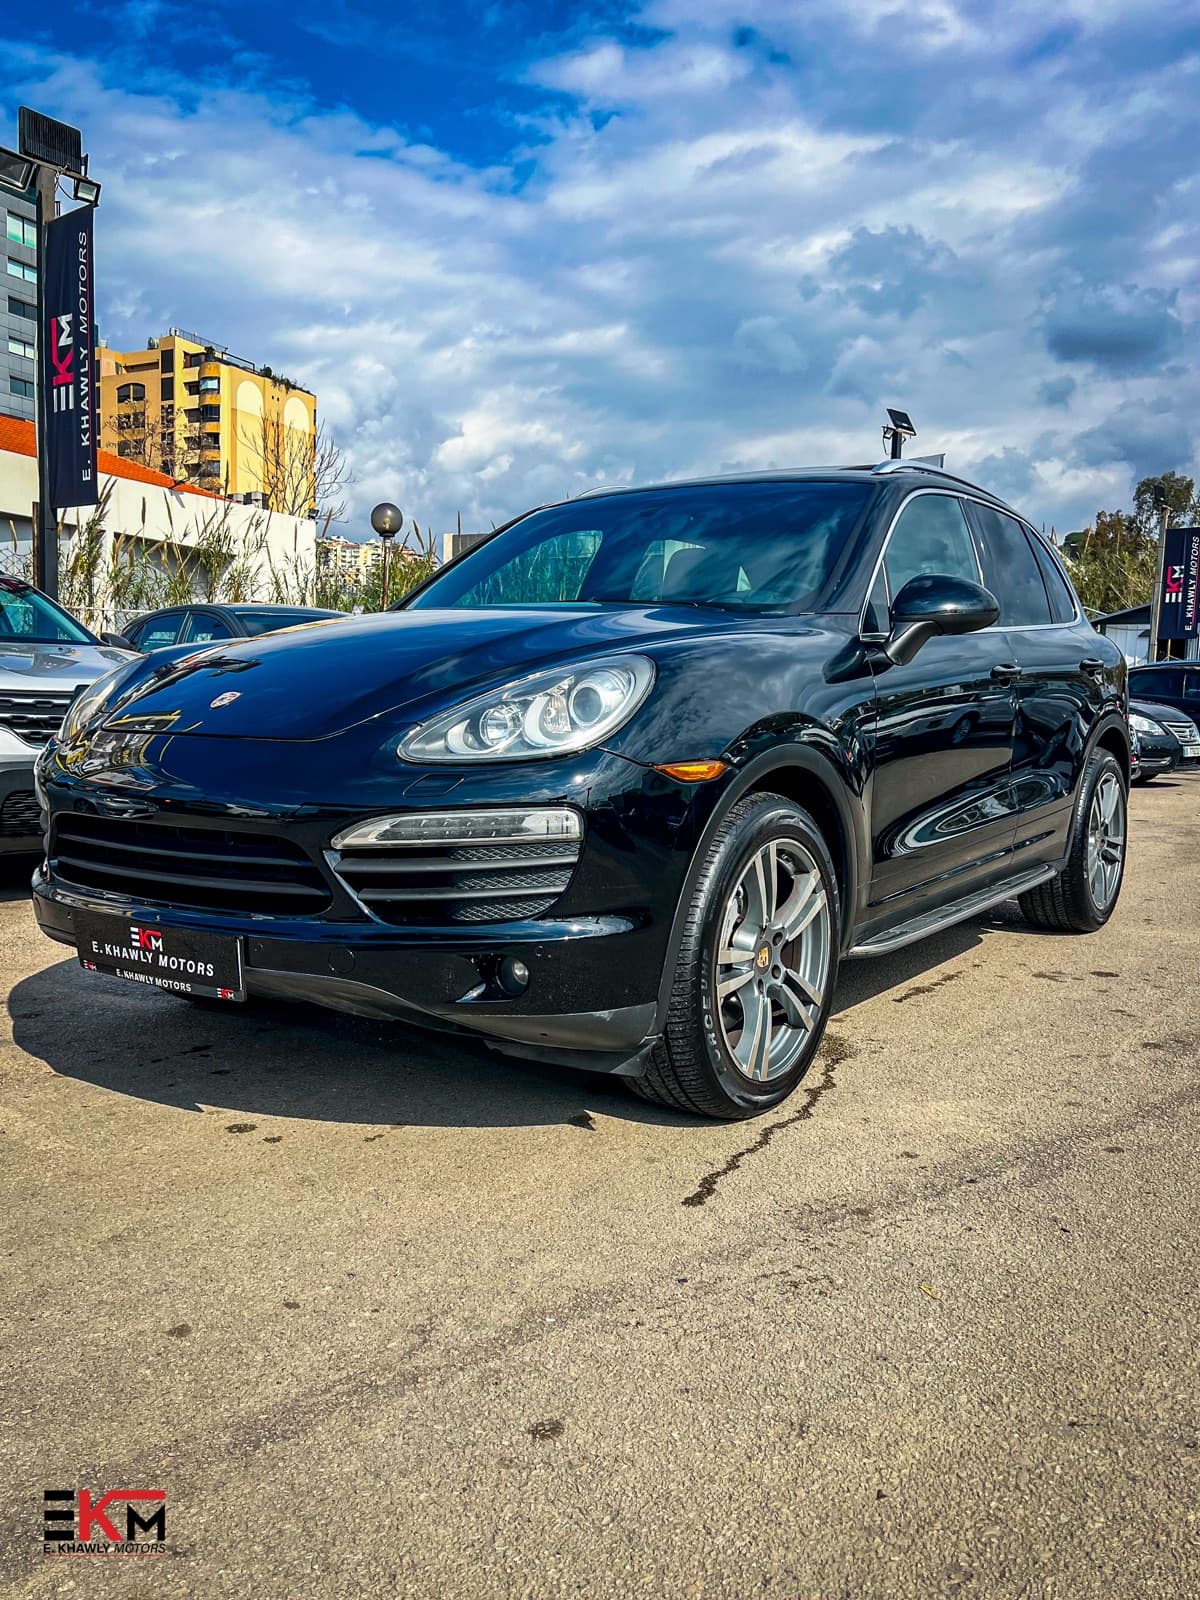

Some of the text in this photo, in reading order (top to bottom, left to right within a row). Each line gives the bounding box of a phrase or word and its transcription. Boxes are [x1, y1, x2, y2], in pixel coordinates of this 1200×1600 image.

[50, 312, 75, 413] EKM
[78, 231, 91, 482] E. KHAWLY MOTORS
[1165, 565, 1185, 603] EKM
[1185, 536, 1200, 630] E. KHAWLY MOTORS
[130, 926, 164, 952] EKM
[158, 954, 214, 977] MOTORS
[155, 977, 192, 992] MOTORS
[702, 995, 727, 1072] ORCE
